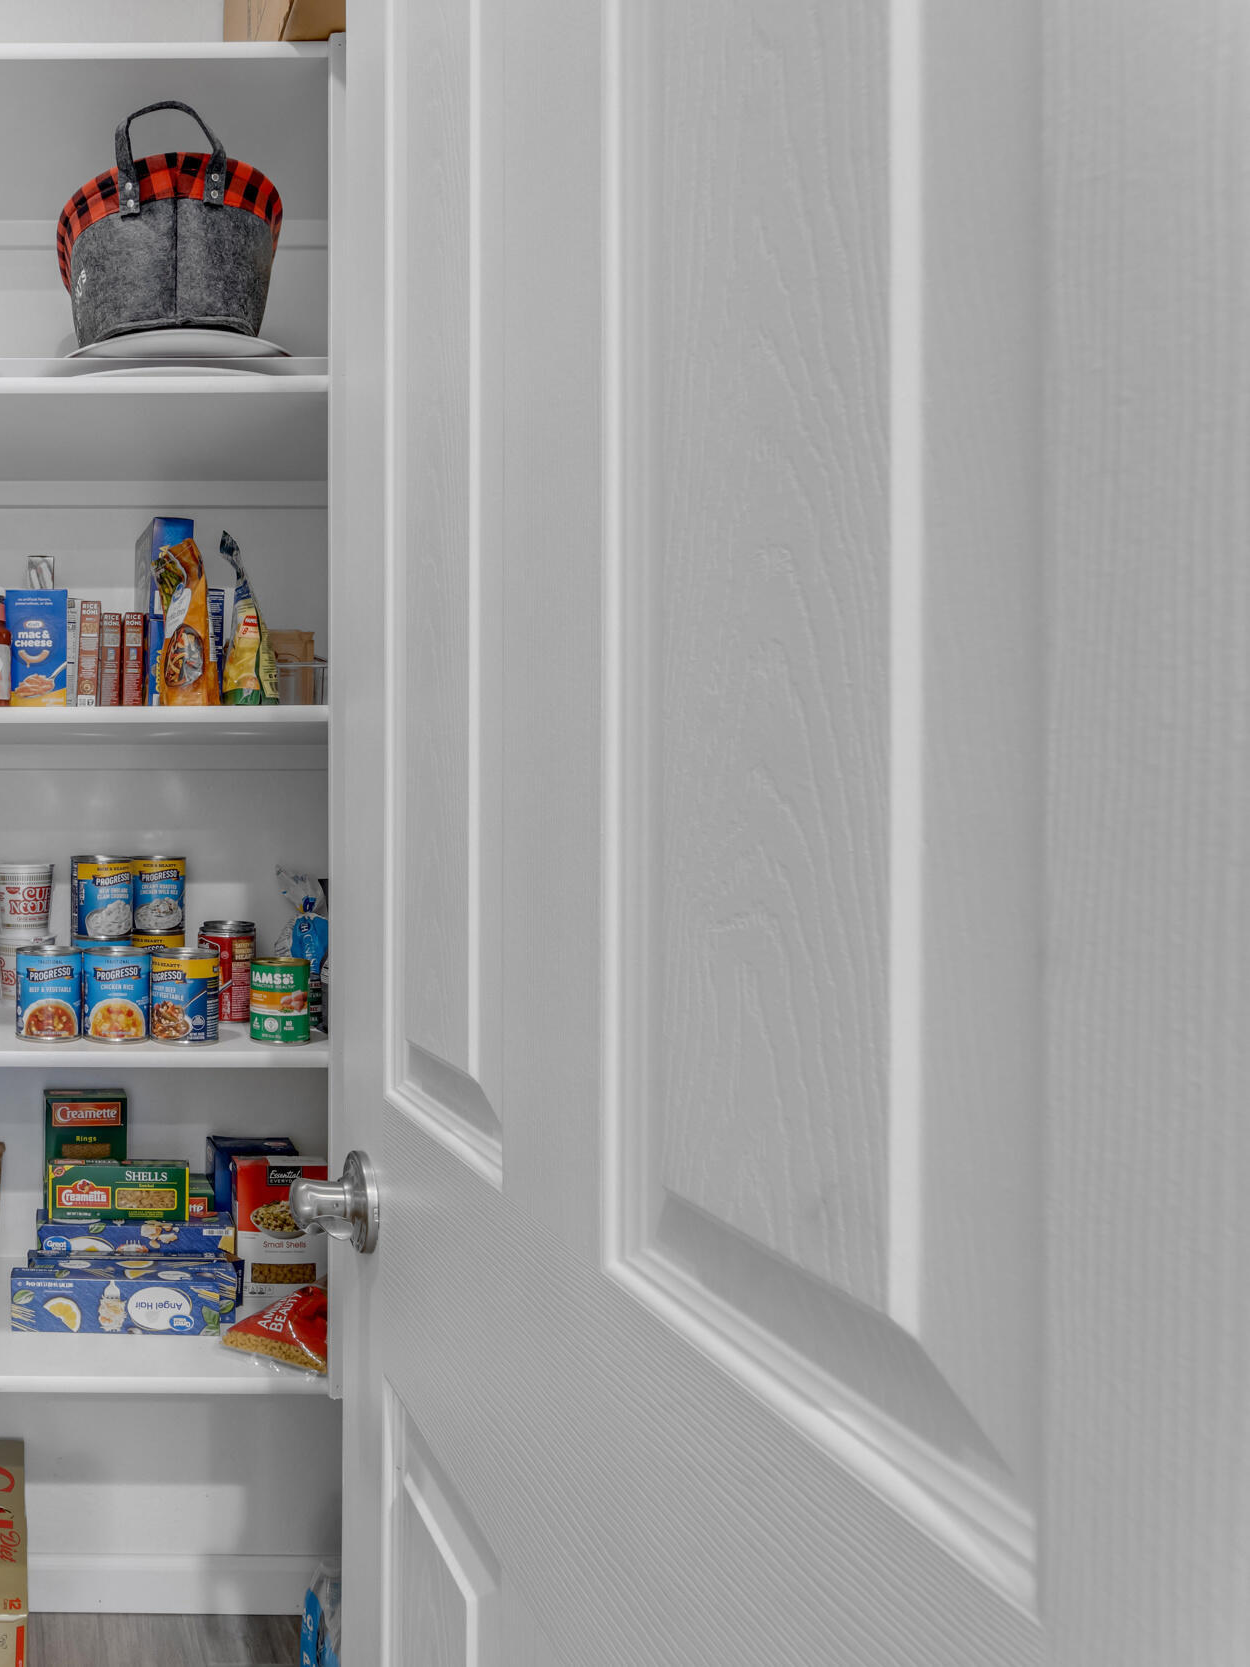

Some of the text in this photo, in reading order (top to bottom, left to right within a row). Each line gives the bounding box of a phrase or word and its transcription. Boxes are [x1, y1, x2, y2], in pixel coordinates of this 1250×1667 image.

[18, 630, 50, 639] mac &
[96, 872, 130, 886] PROGRESSO
[142, 870, 178, 882] PROGRESSO
[9, 900, 50, 914] NOODL
[30, 968, 71, 981] PROGRESSO
[96, 968, 138, 980] PROGRESSO
[252, 971, 282, 984] IAMS
[56, 1106, 118, 1122] Creamette
[76, 1134, 98, 1142] Rings
[125, 1170, 168, 1182] SHELLS
[270, 1168, 300, 1180] Essential
[62, 1189, 107, 1206] Creamette
[46, 1240, 67, 1248] Great
[262, 1240, 307, 1249] Small Shells
[135, 1302, 183, 1312] Angel Hair
[269, 1292, 302, 1333] BEAUTY
[0, 1530, 21, 1563] Diet
[8, 1597, 22, 1610] 12
